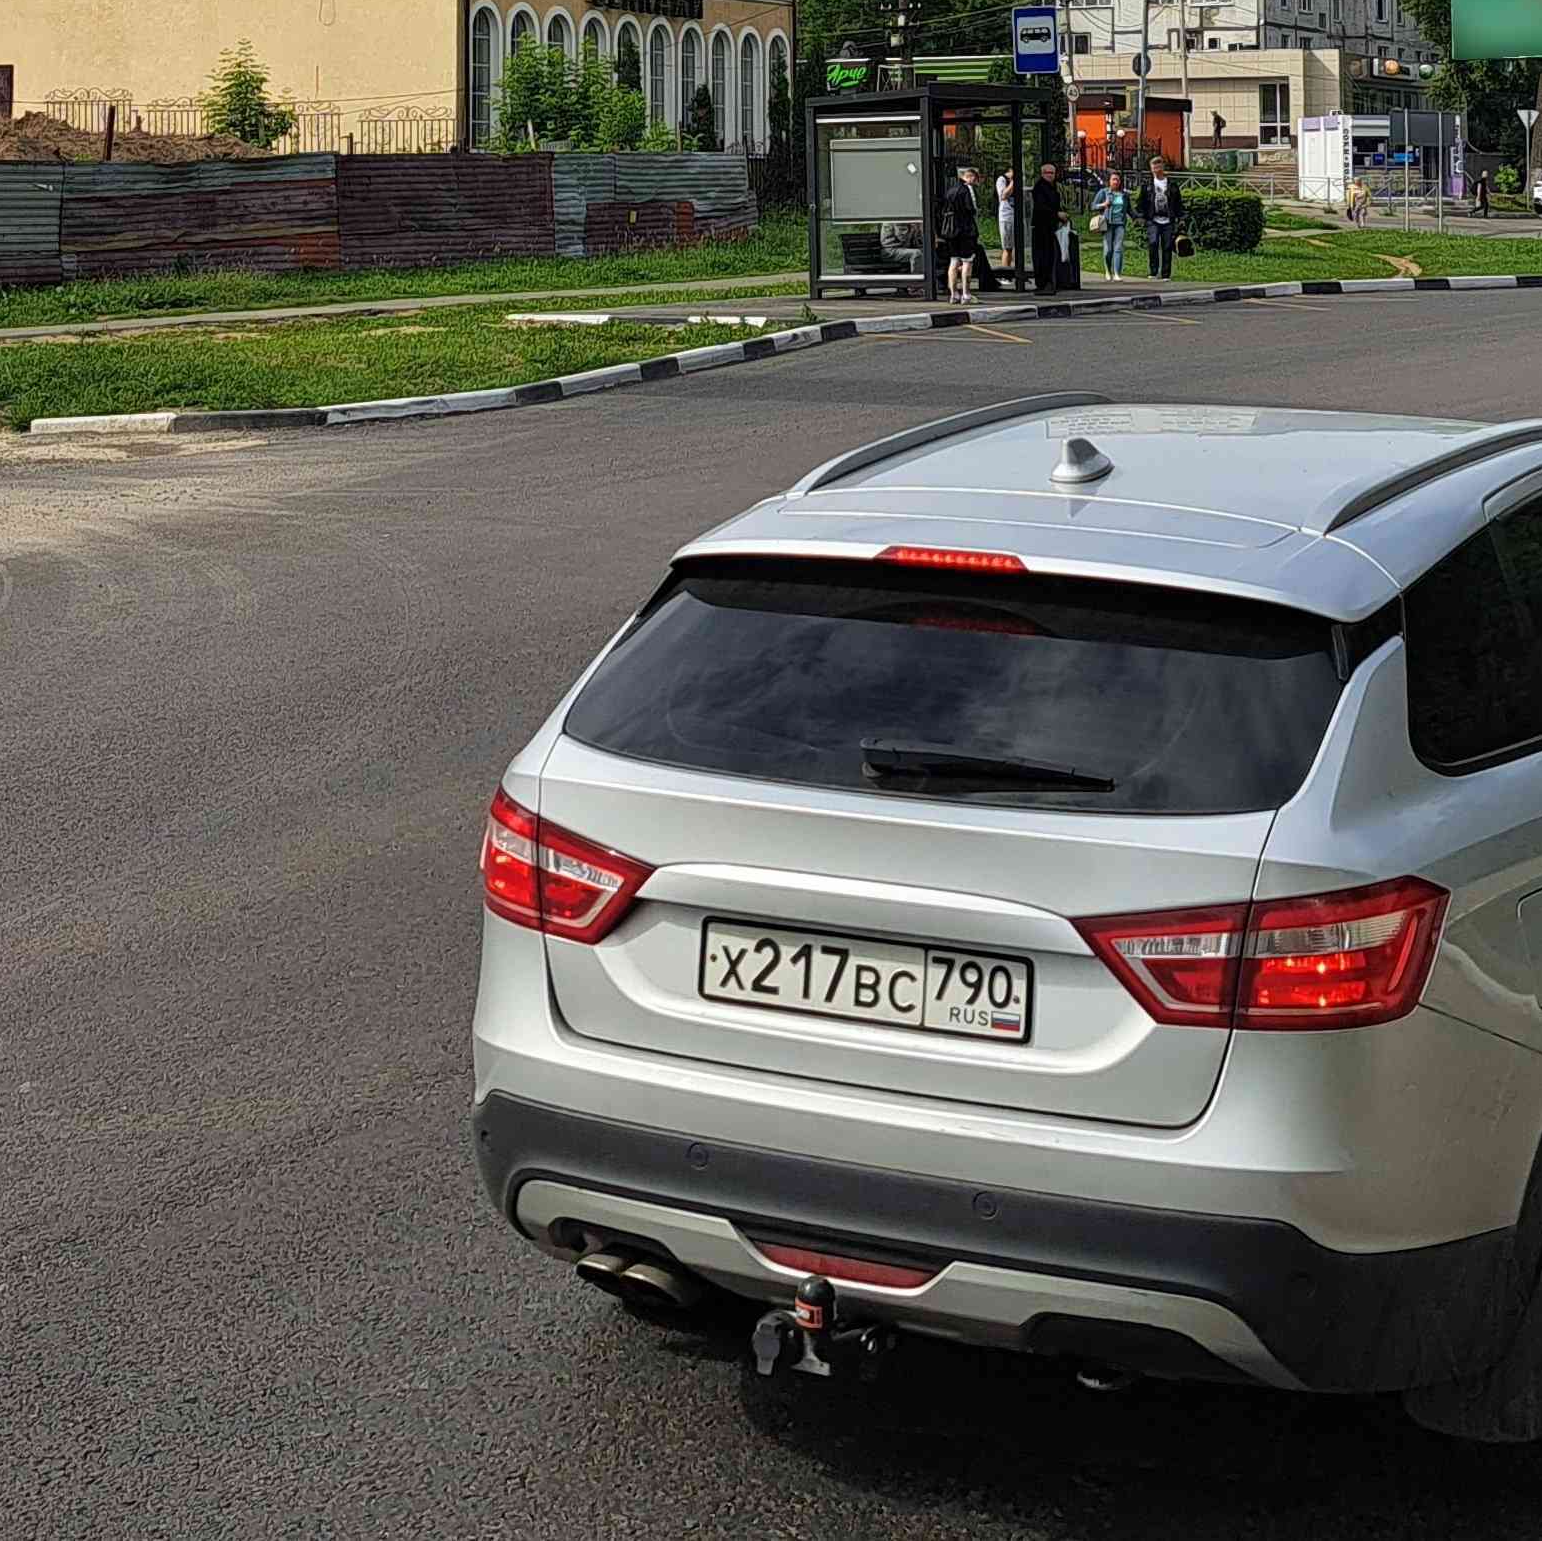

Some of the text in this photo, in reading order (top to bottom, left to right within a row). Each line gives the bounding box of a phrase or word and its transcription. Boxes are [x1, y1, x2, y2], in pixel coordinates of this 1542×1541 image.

[719, 938, 1013, 1014] Х217ВС 790
[950, 1007, 989, 1026] RUS
